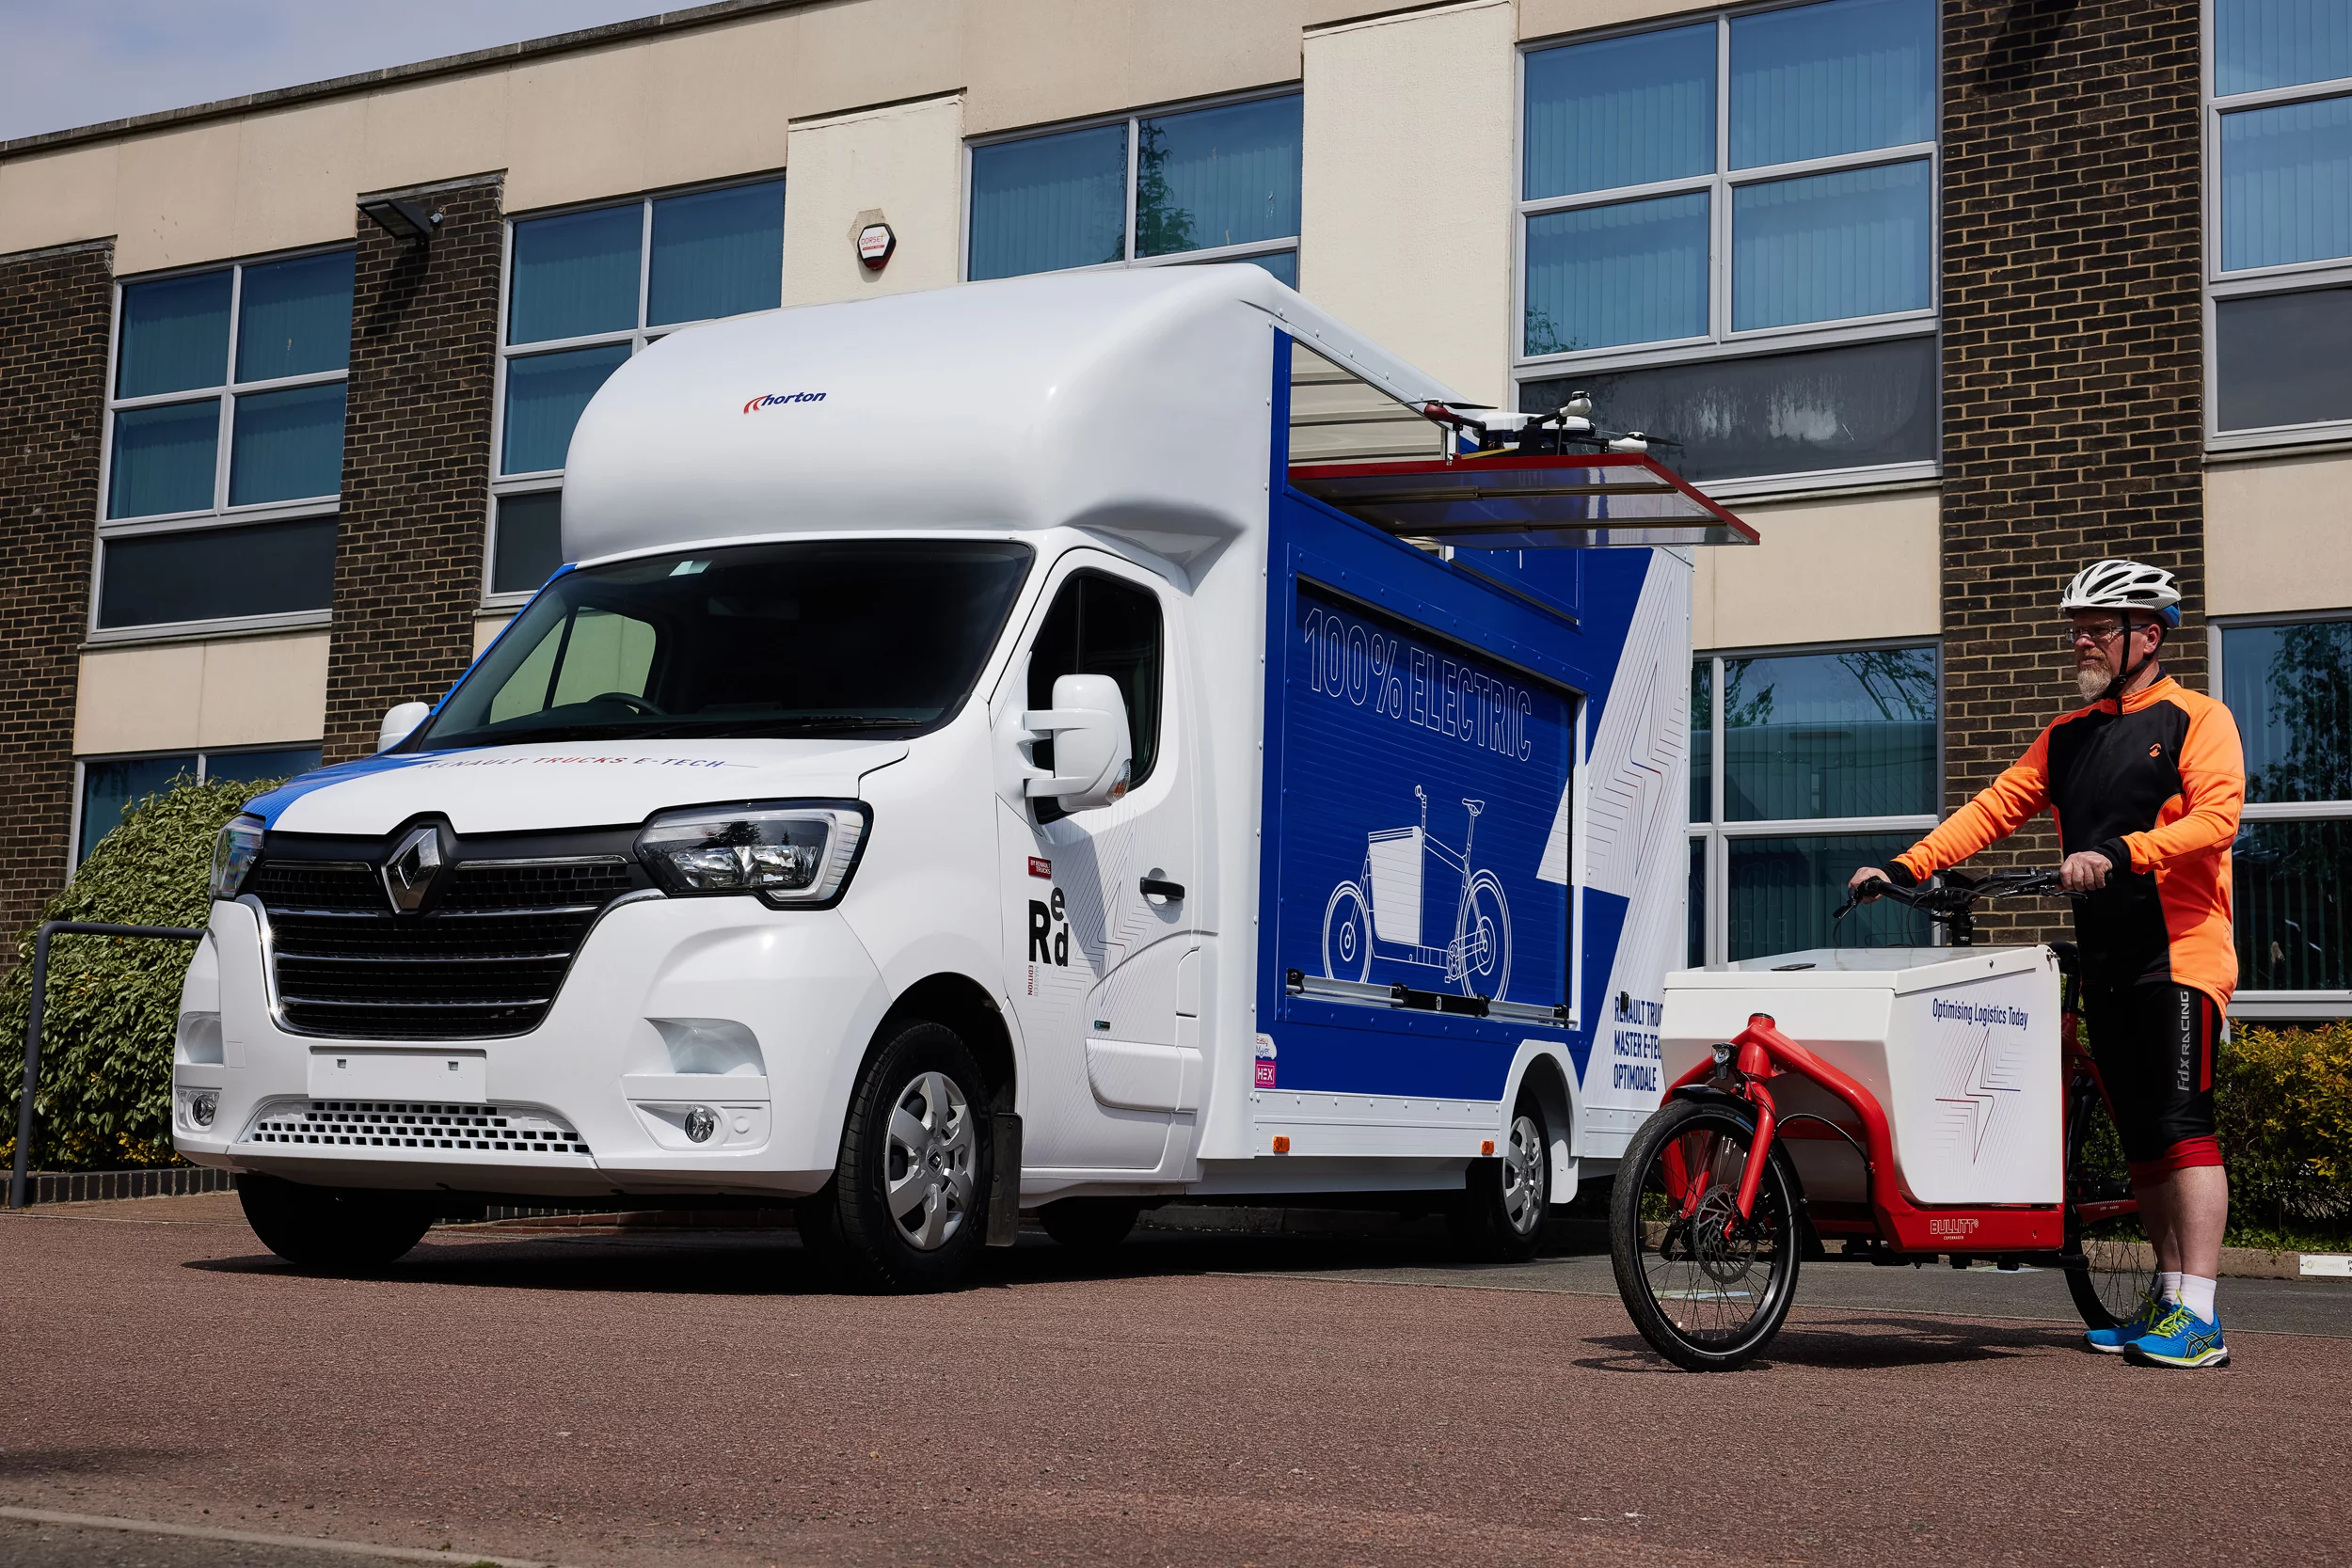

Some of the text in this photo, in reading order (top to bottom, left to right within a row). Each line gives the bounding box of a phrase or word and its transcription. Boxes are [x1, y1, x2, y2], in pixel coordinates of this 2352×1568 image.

[861, 235, 883, 245] DORSET
[761, 392, 827, 406] horton
[1304, 608, 1532, 761] 100% ELECTRIC
[421, 758, 528, 768] RENAULT
[633, 757, 724, 768] E-TECH
[1932, 998, 2028, 1031] Optimising Logistics Today
[2180, 990, 2190, 1055] RACING
[1614, 1030, 1661, 1060] MASTER E-TEC
[1257, 1068, 1273, 1081] HEX
[1613, 1063, 1657, 1092] OPTIMODALE
